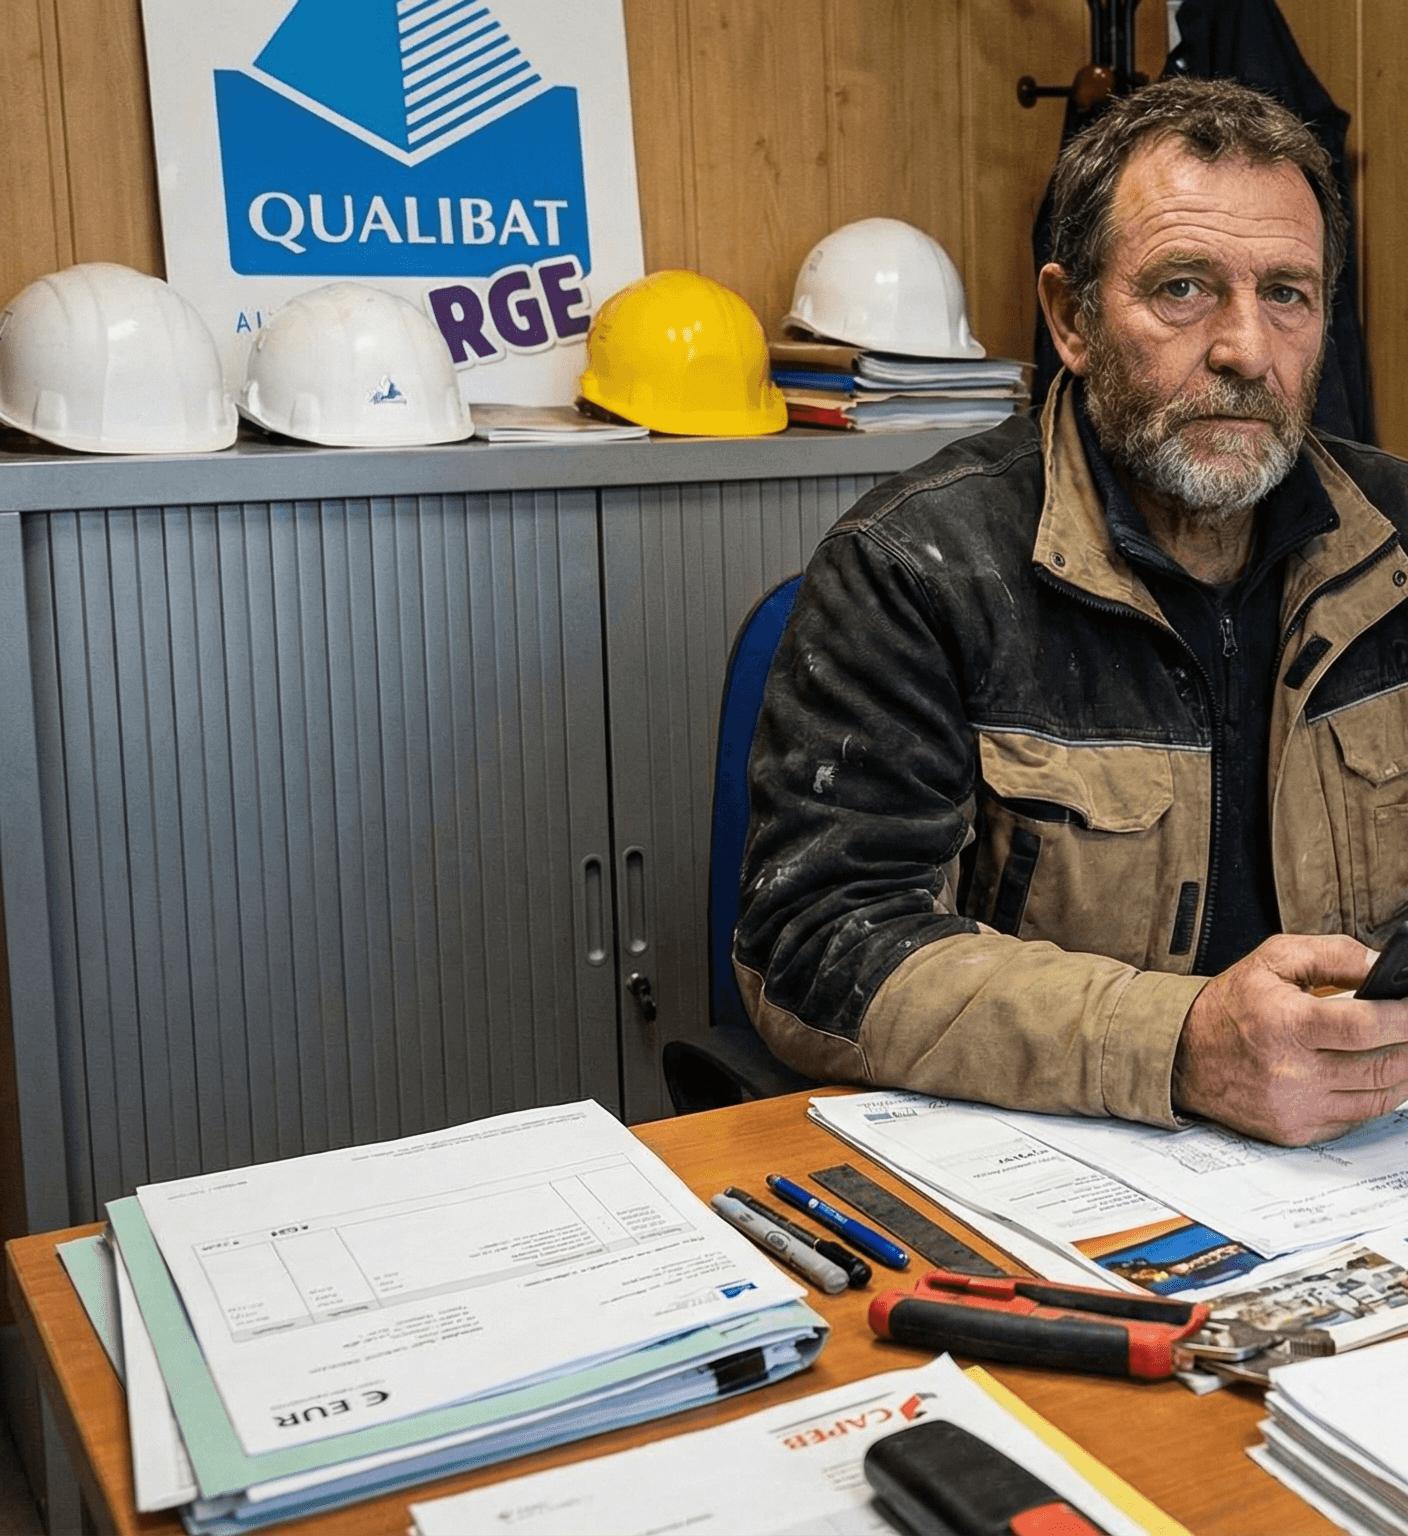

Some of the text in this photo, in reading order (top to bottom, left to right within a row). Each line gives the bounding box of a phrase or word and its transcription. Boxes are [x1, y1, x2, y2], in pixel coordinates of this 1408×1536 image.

[248, 191, 569, 254] QUALIBAT
[427, 260, 592, 365] RGE
[272, 1390, 390, 1428] € EUR
[783, 1407, 893, 1450] CAPEB
